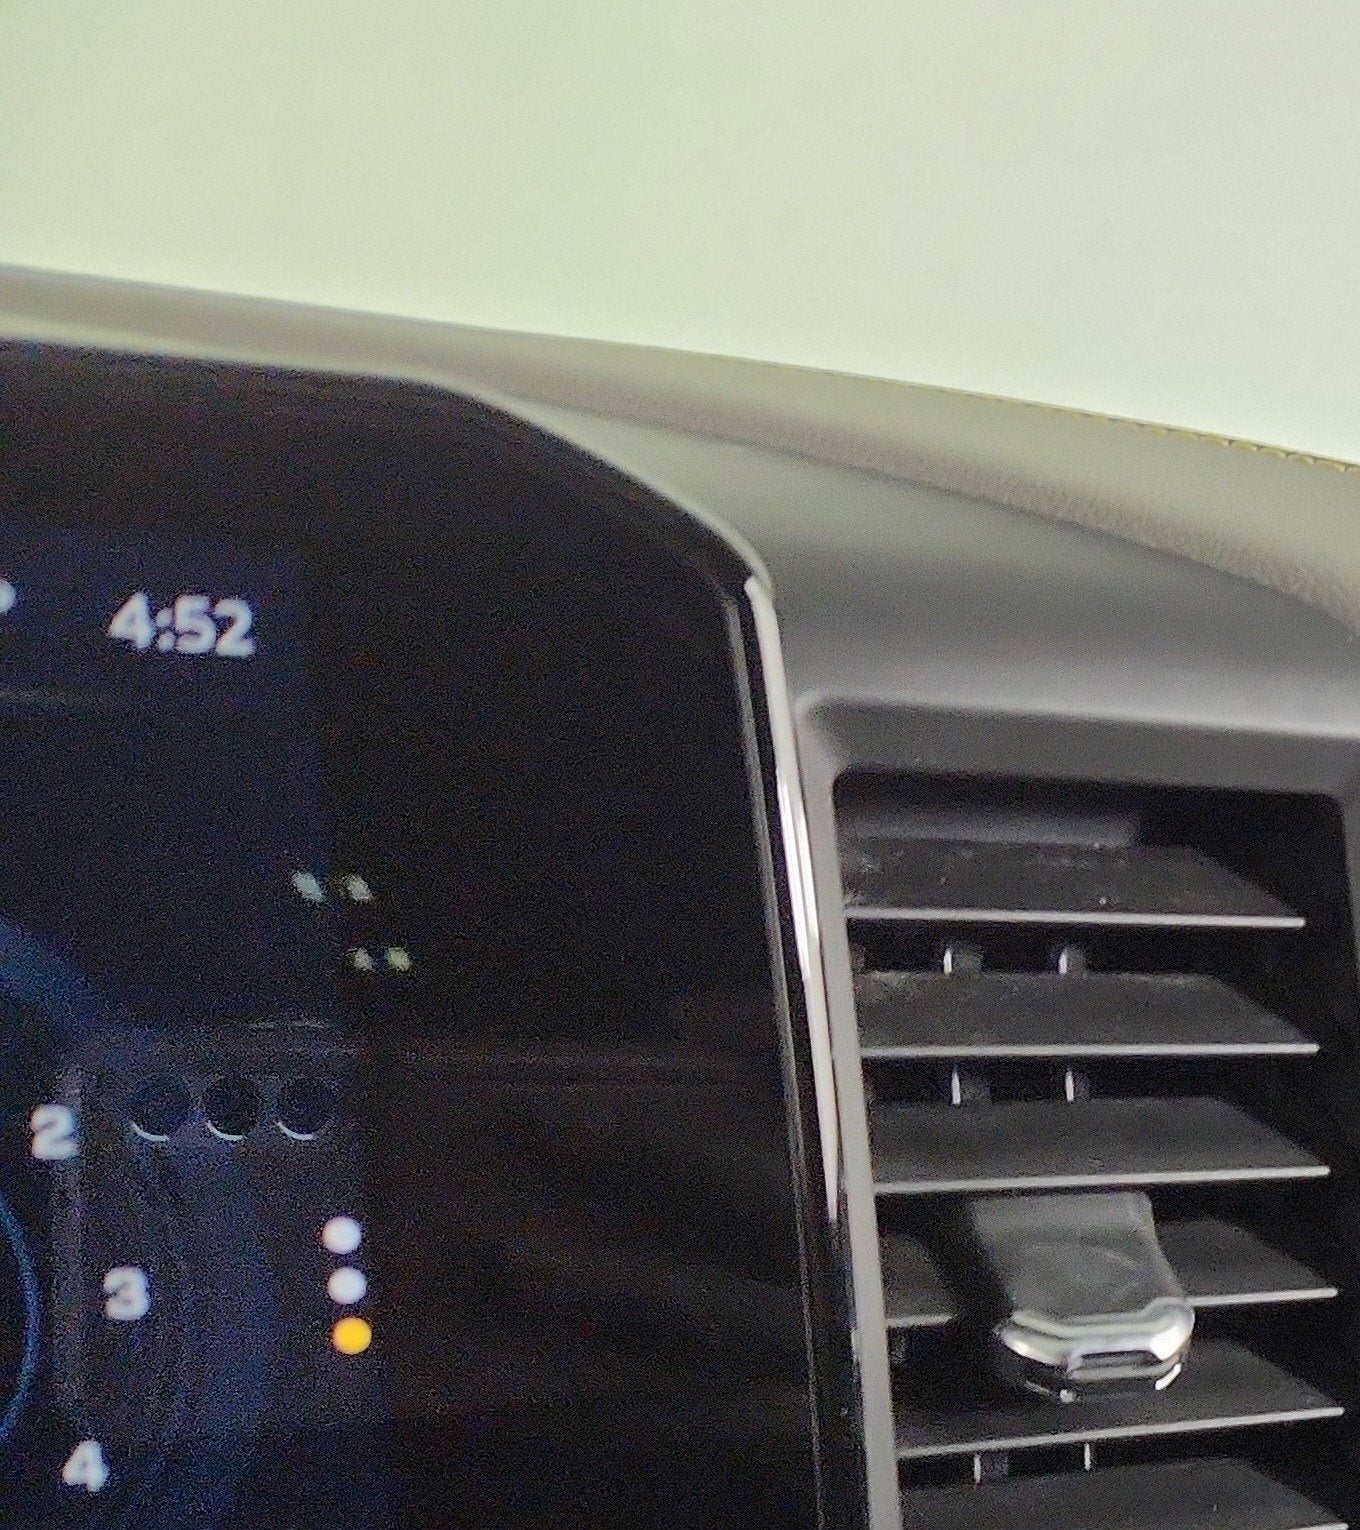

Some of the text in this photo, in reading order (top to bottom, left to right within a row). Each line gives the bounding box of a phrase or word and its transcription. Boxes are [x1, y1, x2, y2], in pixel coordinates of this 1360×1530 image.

[107, 592, 257, 658] 4:52
[30, 1102, 79, 1160] 2
[103, 1265, 151, 1322] 3
[62, 1439, 110, 1493] 4
